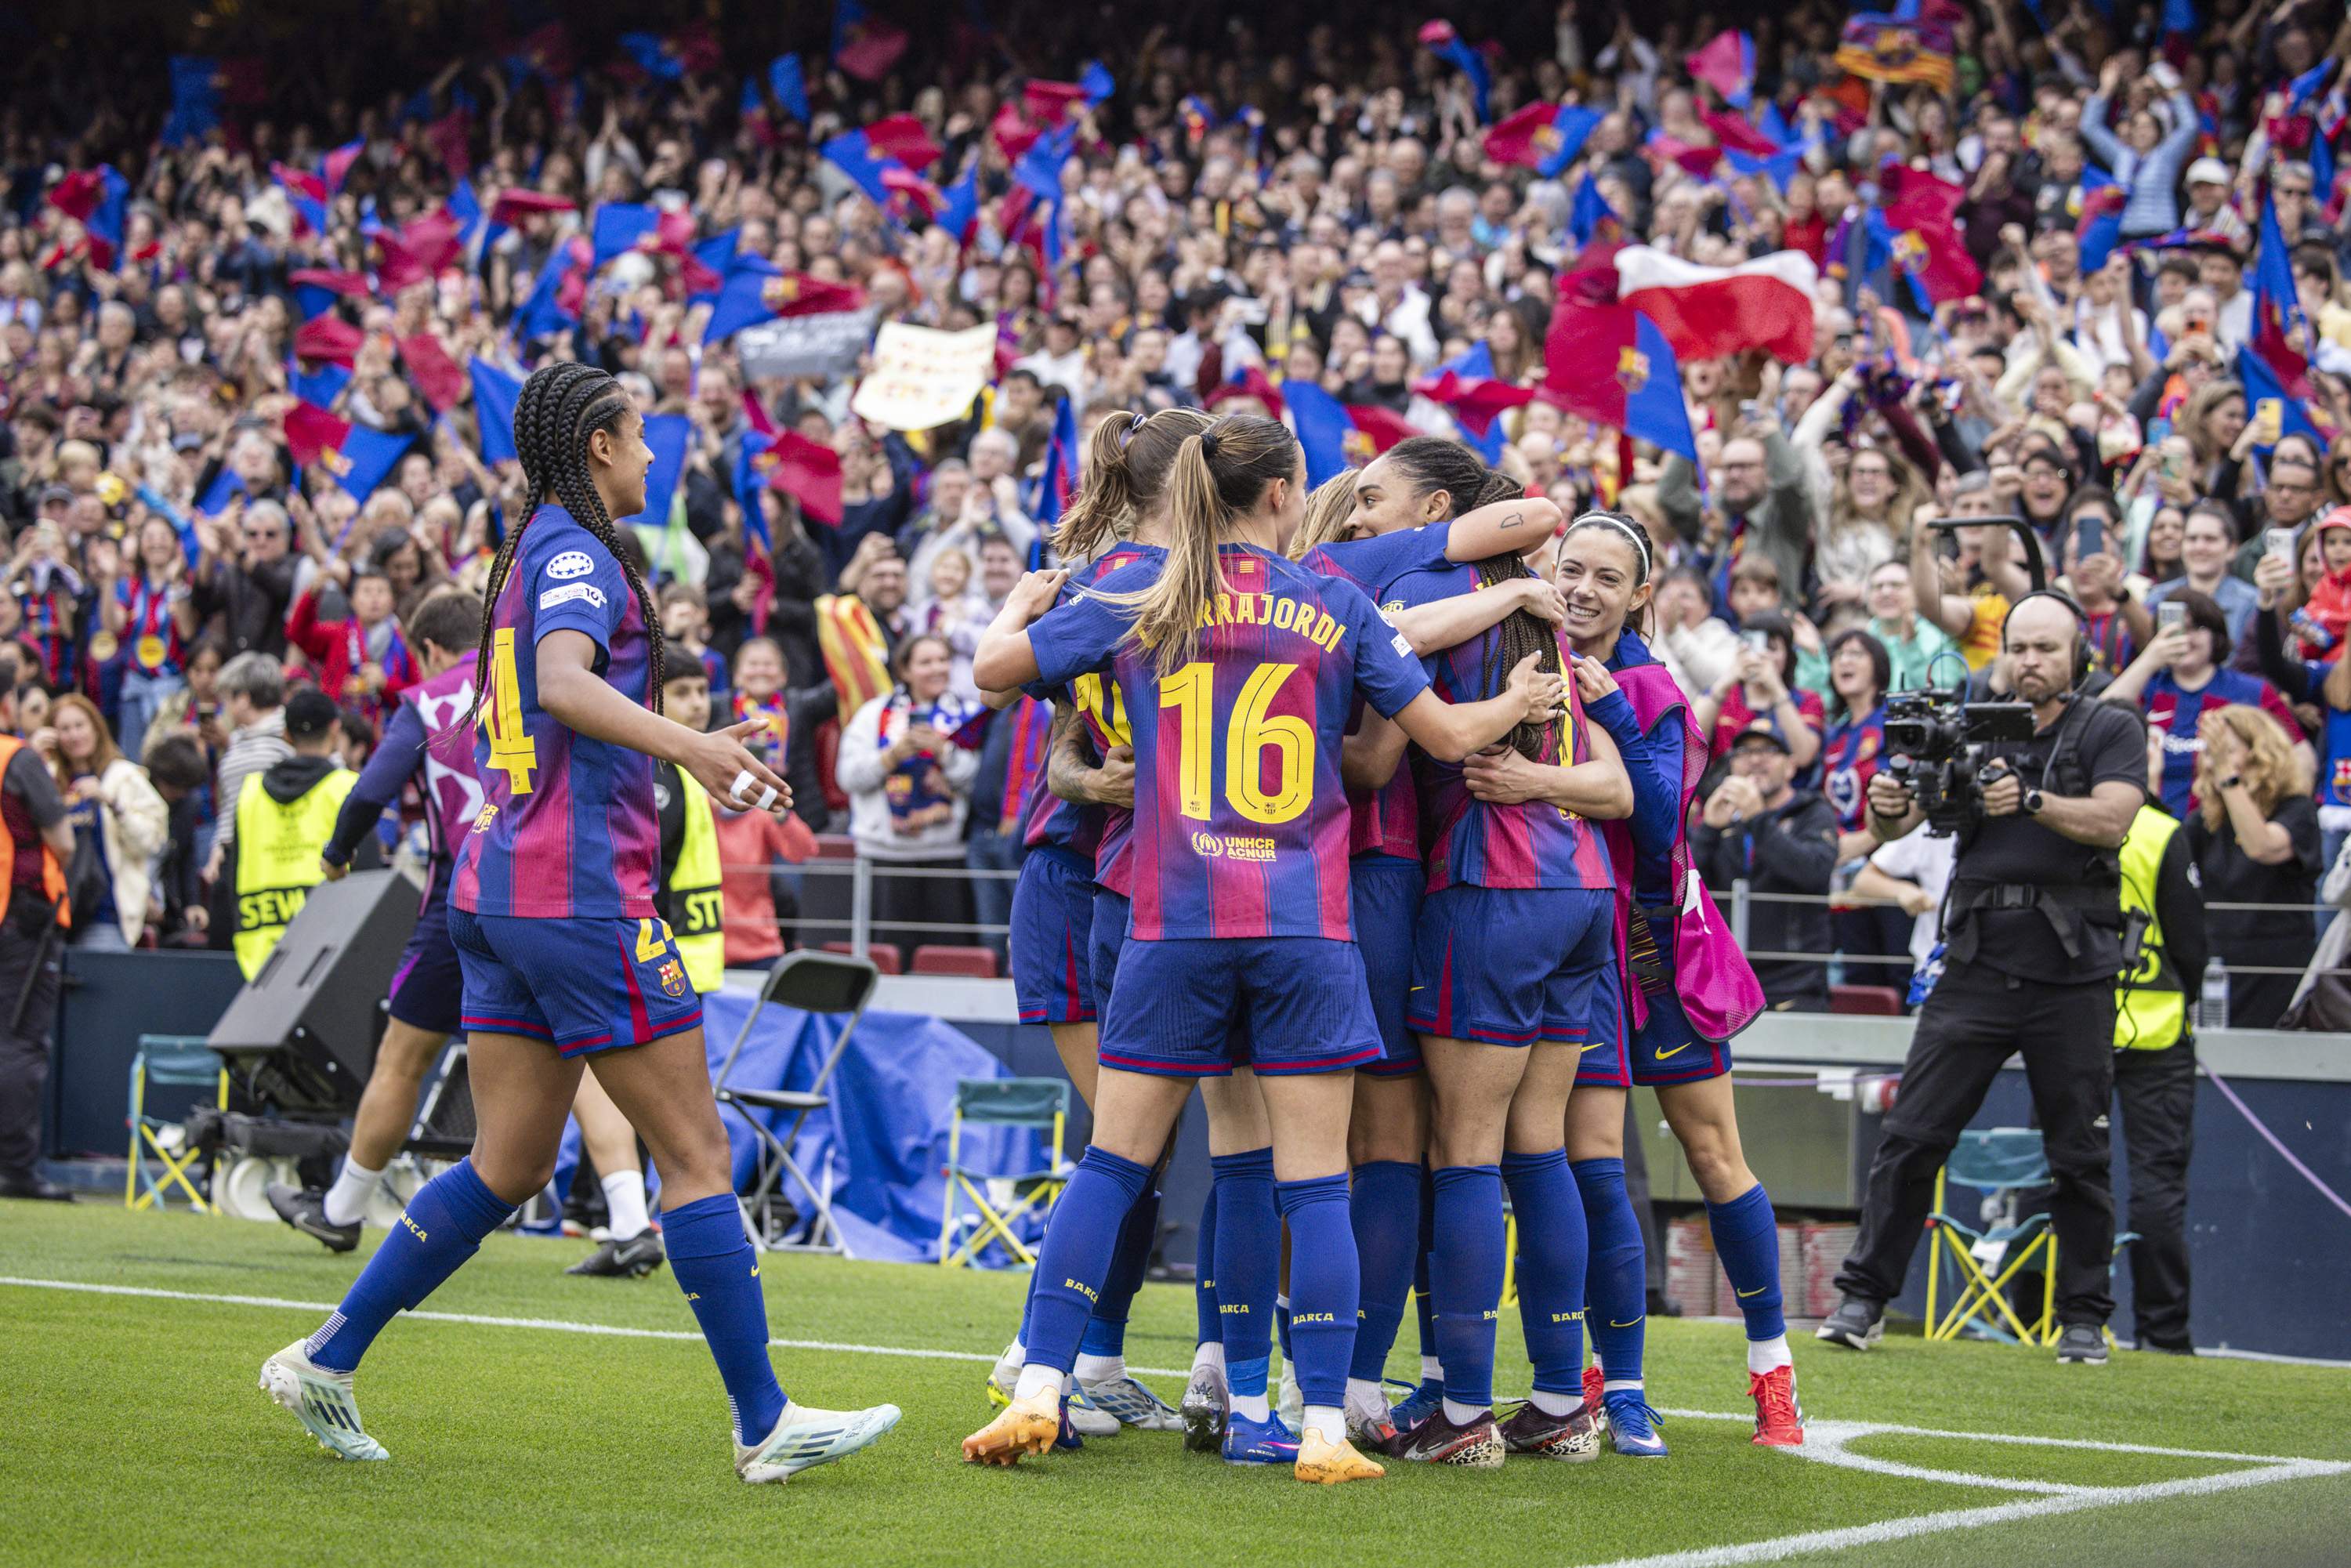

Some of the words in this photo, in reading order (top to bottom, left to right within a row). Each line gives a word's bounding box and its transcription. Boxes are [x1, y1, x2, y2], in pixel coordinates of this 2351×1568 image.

[1139, 592, 1346, 654] RRAJORDI
[474, 627, 538, 795] 4
[1159, 662, 1316, 824] 16
[1225, 836, 1275, 849] UNHCR
[1226, 847, 1277, 859] ACNUR
